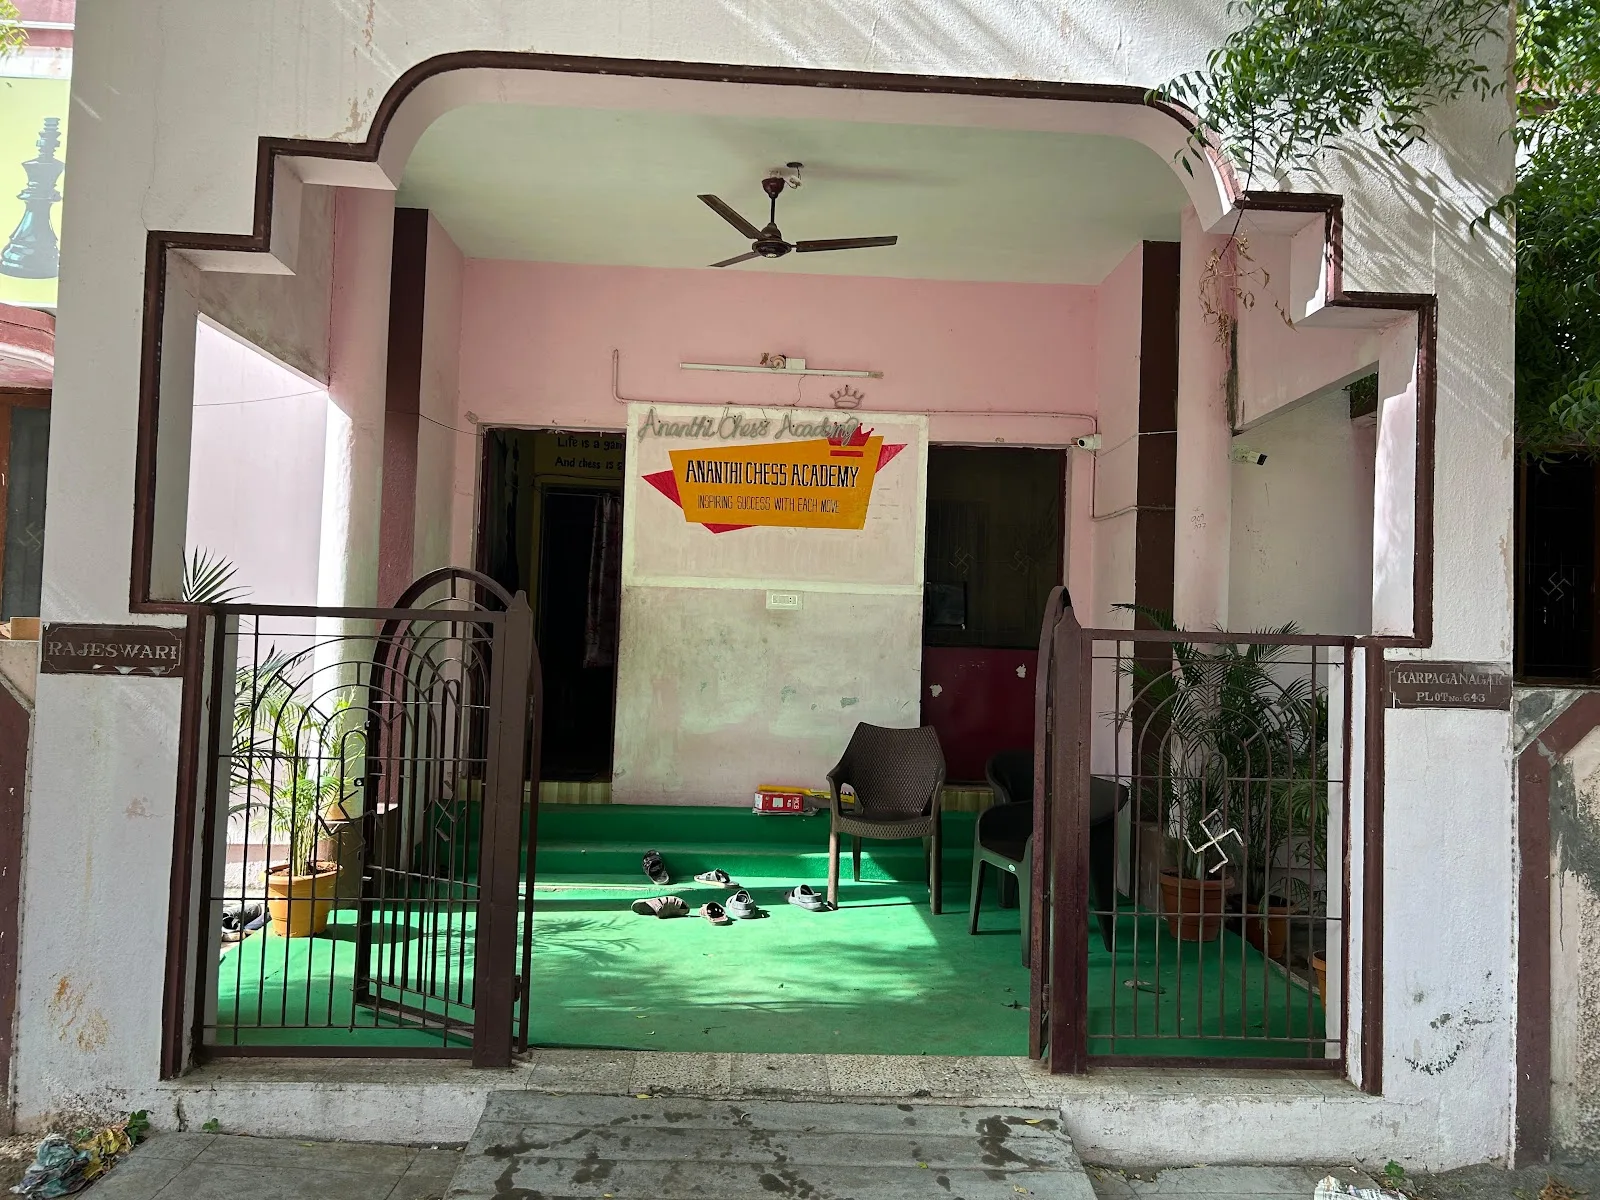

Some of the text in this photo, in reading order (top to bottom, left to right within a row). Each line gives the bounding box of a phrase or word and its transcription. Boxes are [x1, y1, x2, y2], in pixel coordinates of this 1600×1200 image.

[638, 407, 716, 442] Ananthi
[716, 411, 769, 440] Chess
[557, 436, 578, 448] Life
[582, 440, 590, 448] is
[593, 440, 600, 449] a
[554, 456, 576, 468] And
[578, 458, 601, 469] chess
[605, 461, 614, 469] is
[685, 460, 860, 488] ANANTHI CHESS ACADEMY
[697, 494, 840, 514] INSPIRING SUCCESS WITH EACH MOVE
[48, 641, 177, 660] RAJESWARI
